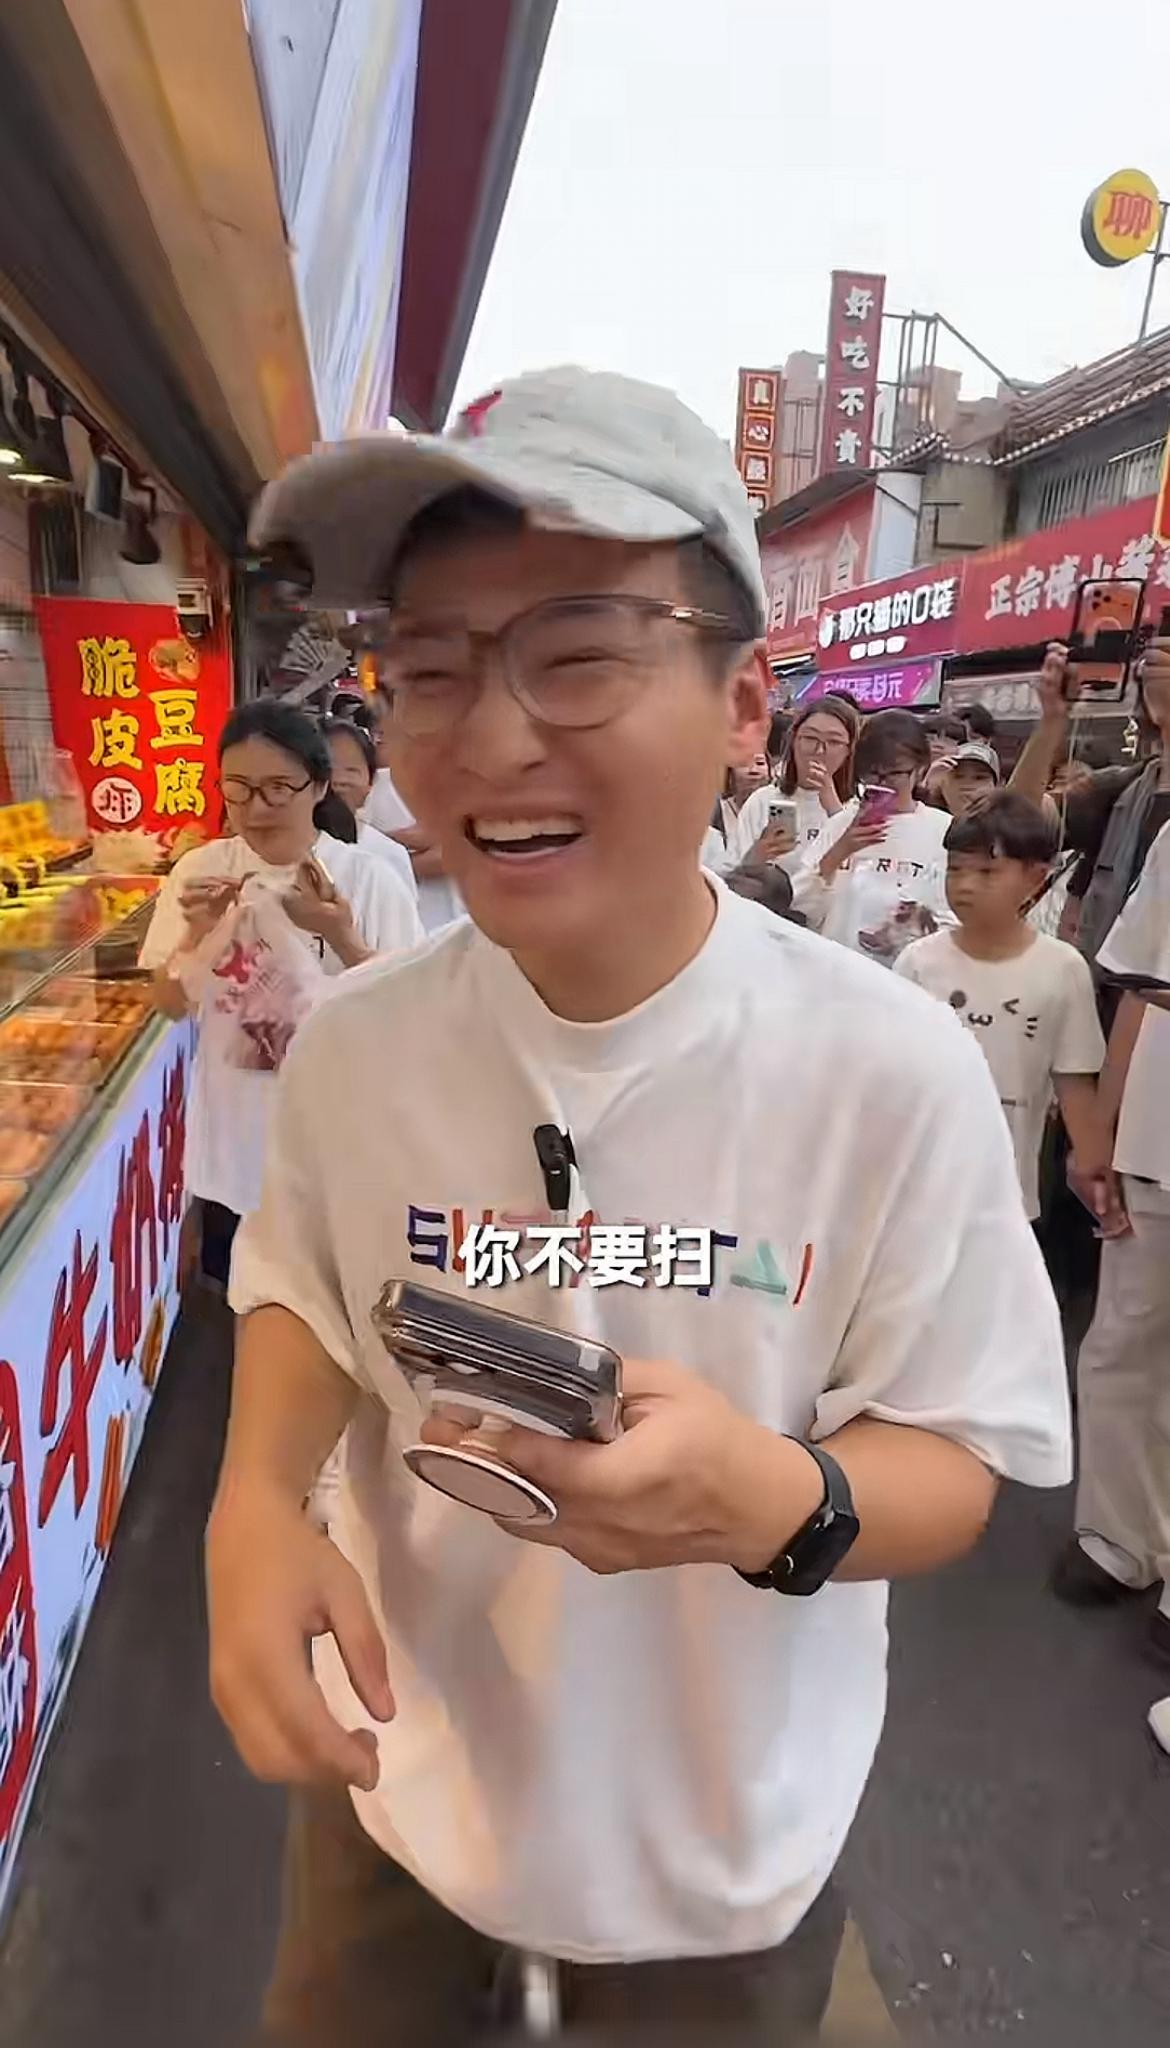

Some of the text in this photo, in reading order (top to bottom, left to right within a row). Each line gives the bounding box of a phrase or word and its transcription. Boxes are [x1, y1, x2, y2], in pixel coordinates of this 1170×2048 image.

[834, 285, 874, 465] 好吃不贵
[77, 635, 143, 770] 脆皮
[147, 689, 206, 817] 豆腐
